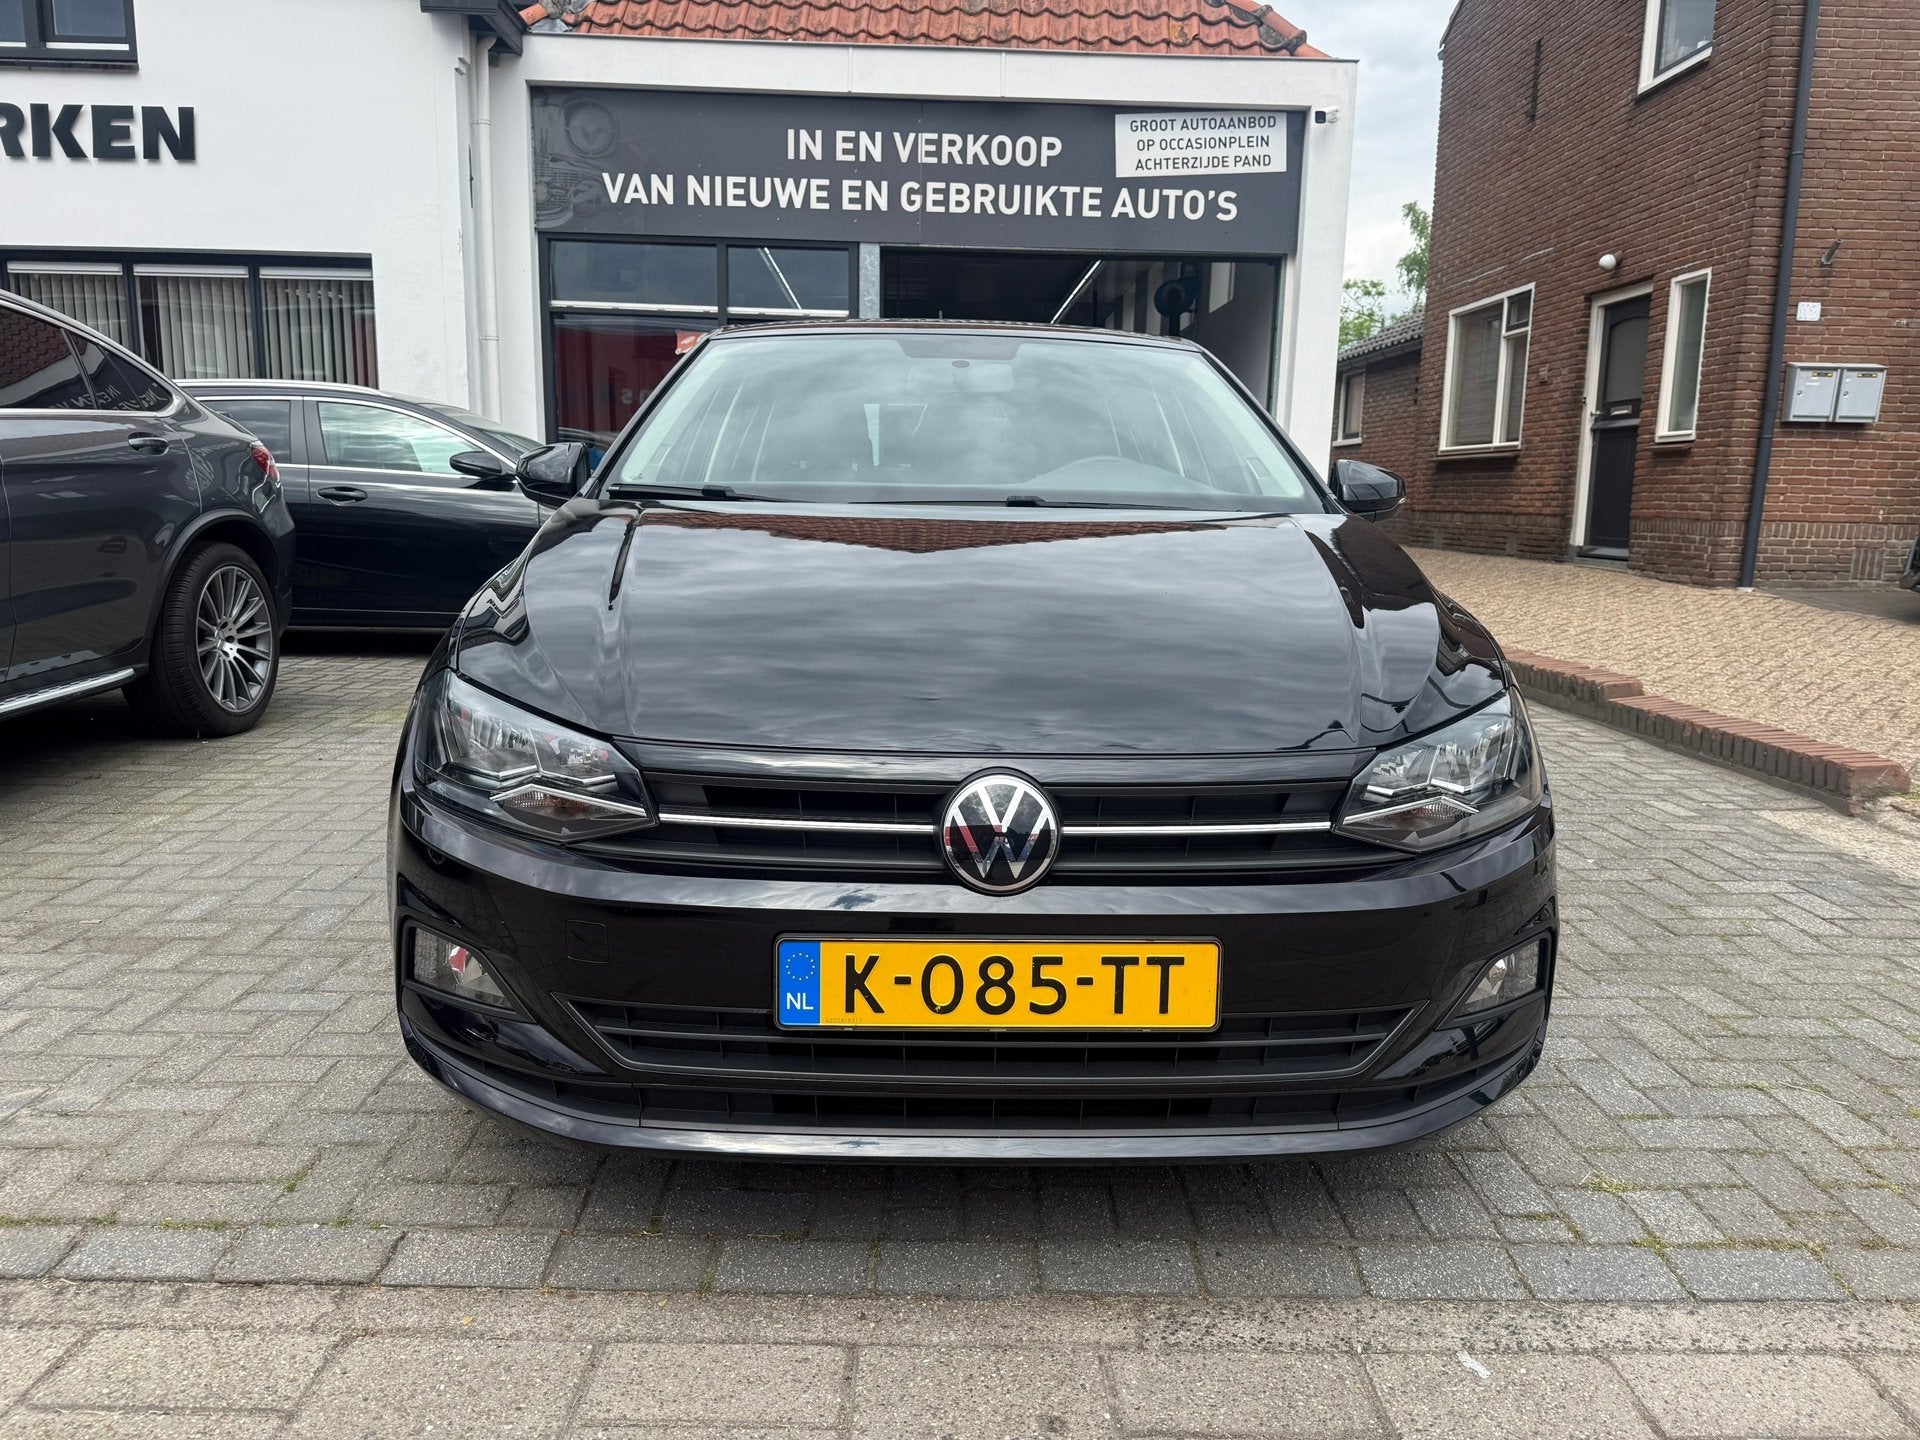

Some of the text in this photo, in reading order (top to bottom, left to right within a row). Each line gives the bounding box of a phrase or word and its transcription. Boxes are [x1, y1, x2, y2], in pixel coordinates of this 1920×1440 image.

[1130, 116, 1277, 133] GROOT AUTOAANBOD
[787, 128, 1063, 168] IN EN VERKOOP
[1136, 135, 1270, 152] OP OCCASIONPLEIN
[1135, 154, 1272, 171] ACHTERZIJDE PAND
[601, 172, 1239, 222] VAN NIEUWE EN GEBRUIKTE AUTO'S
[845, 955, 1185, 1016] K-085-TT
[786, 992, 815, 1010] NL
